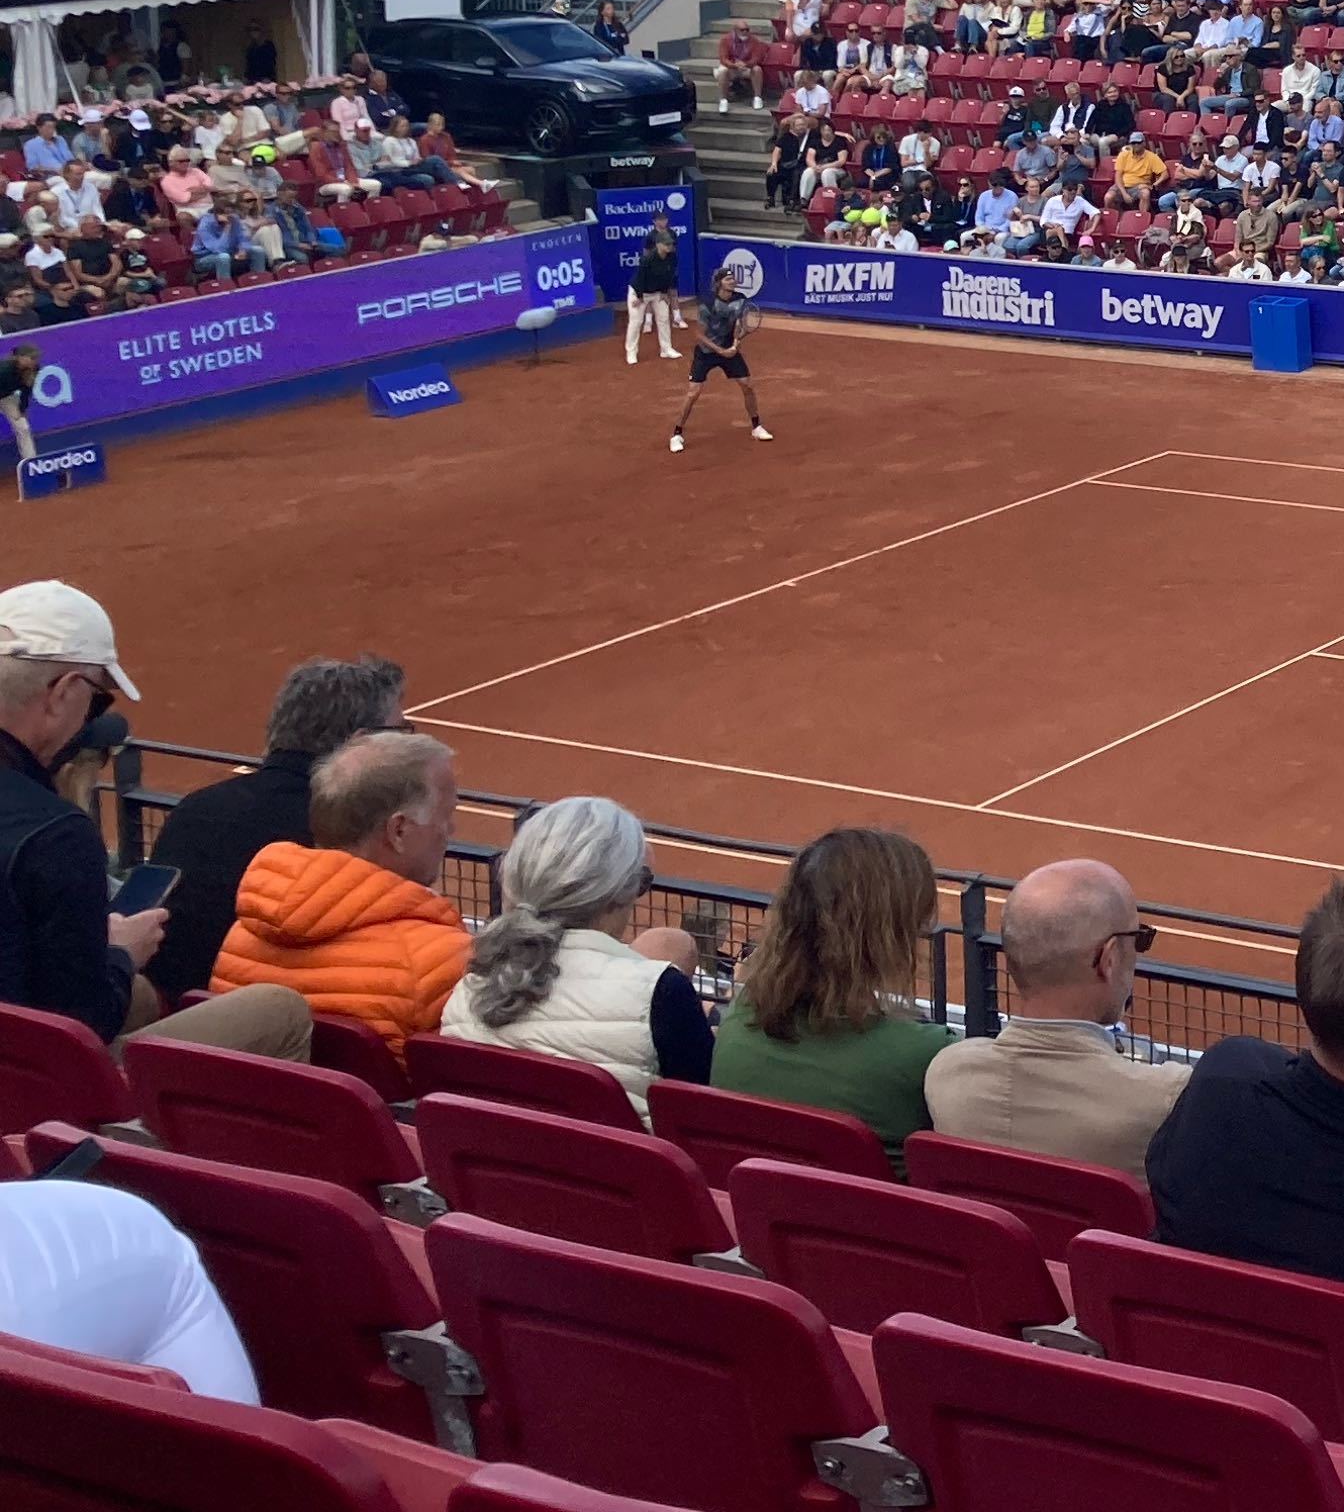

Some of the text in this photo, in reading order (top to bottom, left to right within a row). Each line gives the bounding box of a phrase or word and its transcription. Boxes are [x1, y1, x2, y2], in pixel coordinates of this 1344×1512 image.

[611, 156, 655, 168] betway
[537, 258, 585, 291] 0:05
[805, 262, 895, 292] RIXFM
[357, 272, 522, 325] PORSCHE
[827, 293, 855, 303] MUSIK
[856, 292, 877, 302] JUST
[942, 281, 1055, 326] industri
[1101, 288, 1224, 339] betway
[118, 311, 276, 361] ELITE HOTELS
[140, 343, 263, 385] OF SWEDEN
[387, 378, 451, 406] Nordea
[28, 450, 96, 477] Nordea
